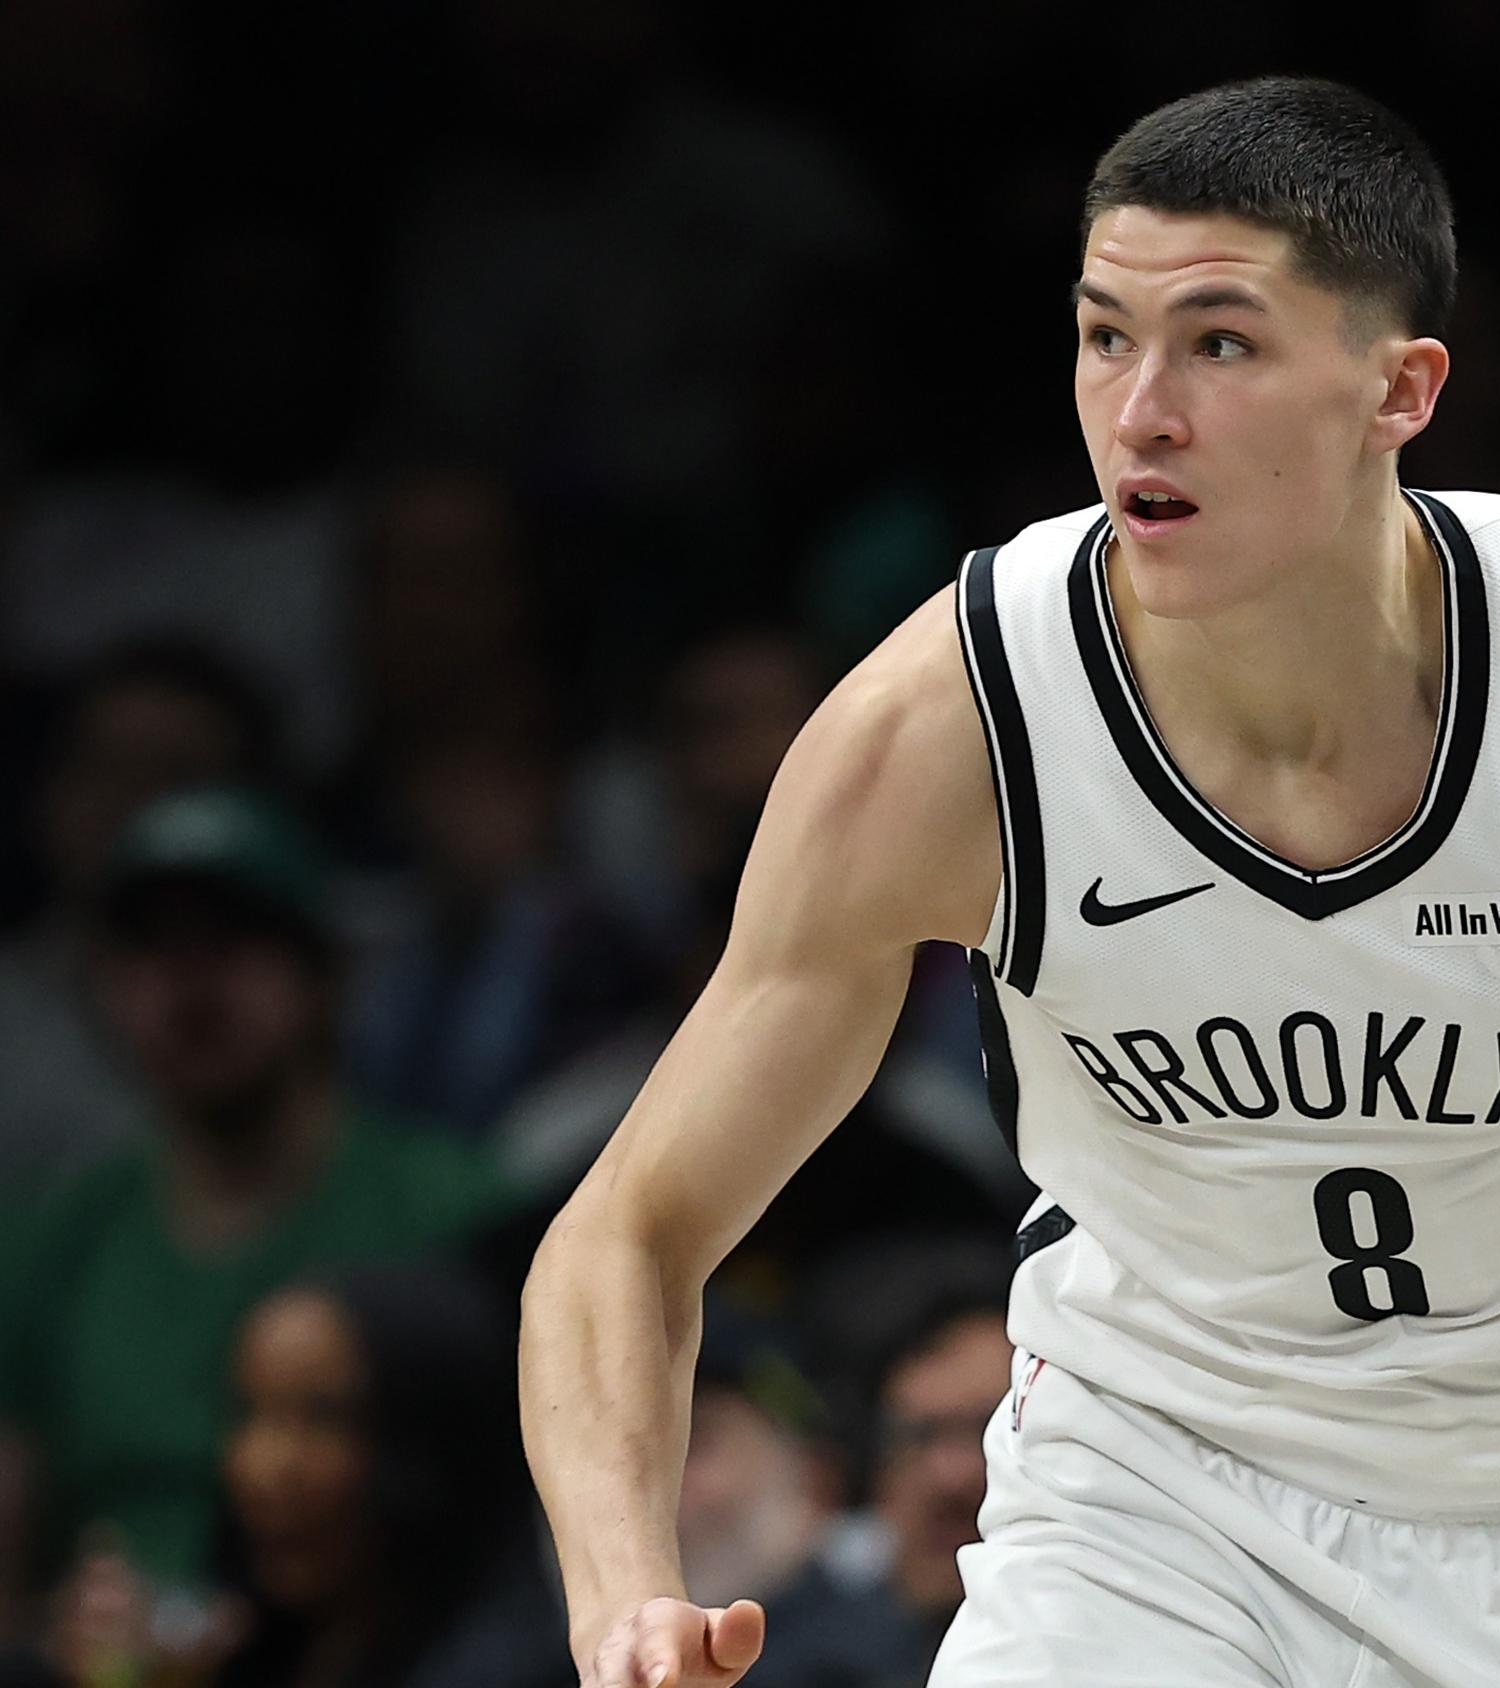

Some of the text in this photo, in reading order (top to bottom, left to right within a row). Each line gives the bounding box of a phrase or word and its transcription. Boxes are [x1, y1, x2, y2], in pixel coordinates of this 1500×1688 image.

[1415, 904, 1452, 936] All
[1459, 904, 1487, 935] In
[1313, 1167, 1430, 1322] 8
